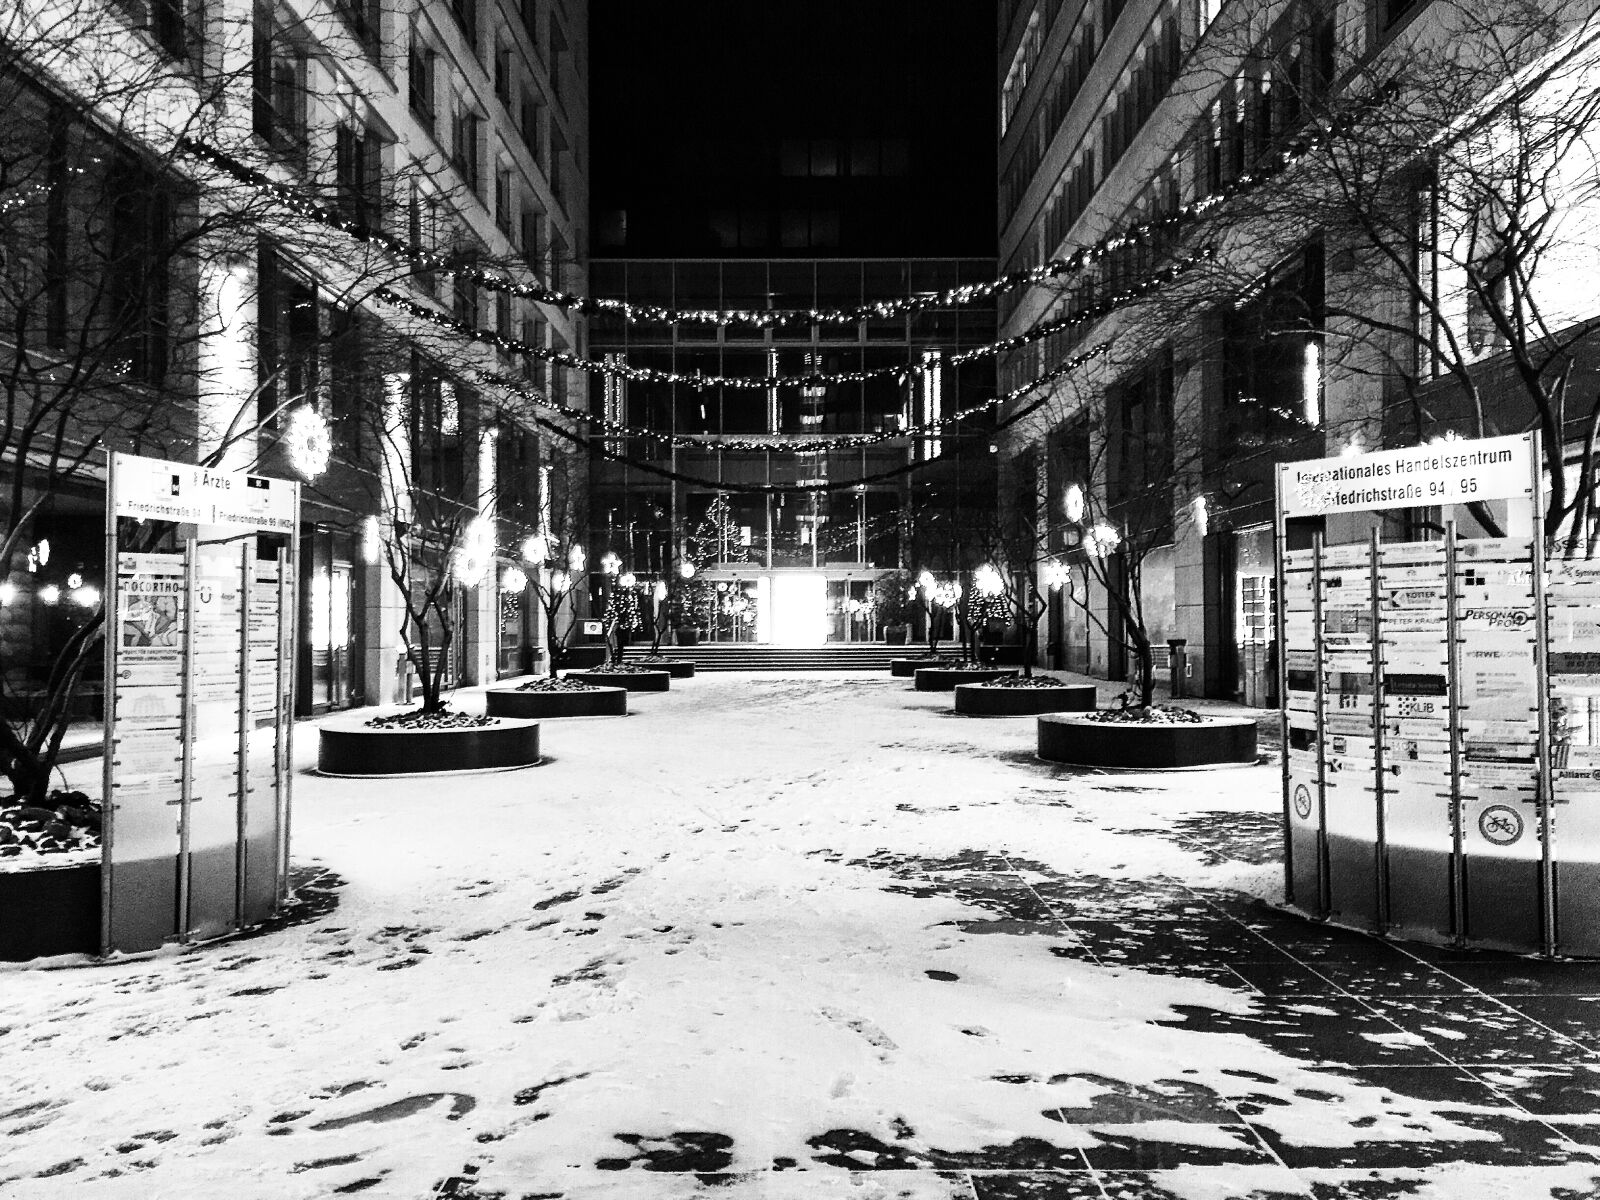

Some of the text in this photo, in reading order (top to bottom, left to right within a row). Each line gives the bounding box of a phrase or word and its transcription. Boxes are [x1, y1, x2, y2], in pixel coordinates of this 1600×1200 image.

[1396, 449, 1513, 474] Handelszentrum
[1325, 483, 1422, 506] iedrichstraße
[1429, 480, 1445, 496] 94
[1460, 477, 1478, 494] 95
